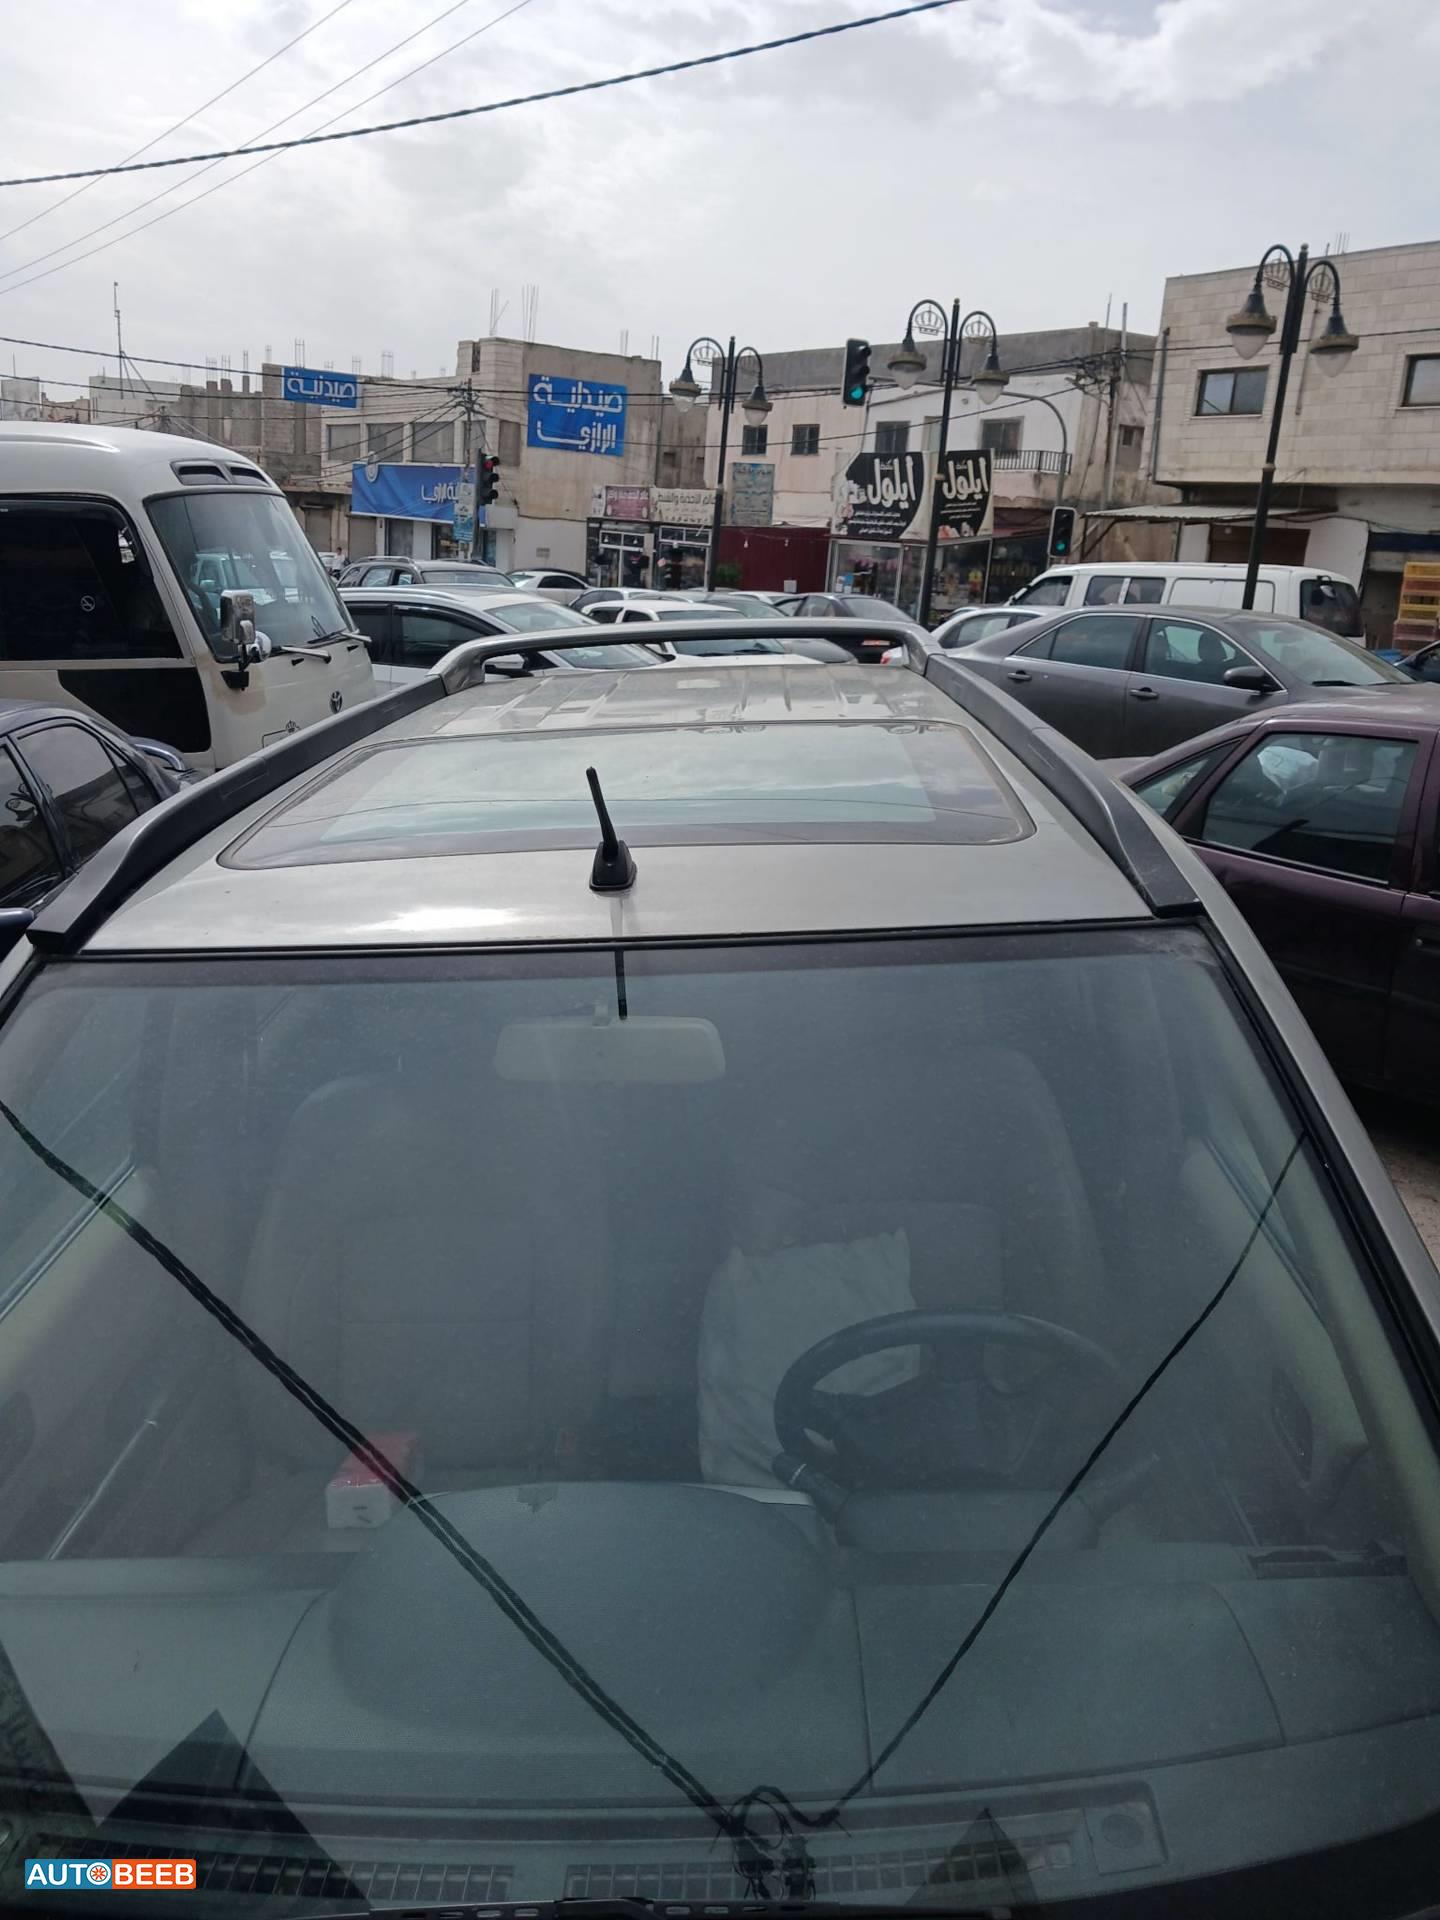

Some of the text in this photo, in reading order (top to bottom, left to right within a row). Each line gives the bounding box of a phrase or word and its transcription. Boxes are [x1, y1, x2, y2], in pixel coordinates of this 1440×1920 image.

[286, 371, 356, 402] صيدلية
[533, 376, 622, 417] صيدلية
[537, 421, 616, 453] الرازي
